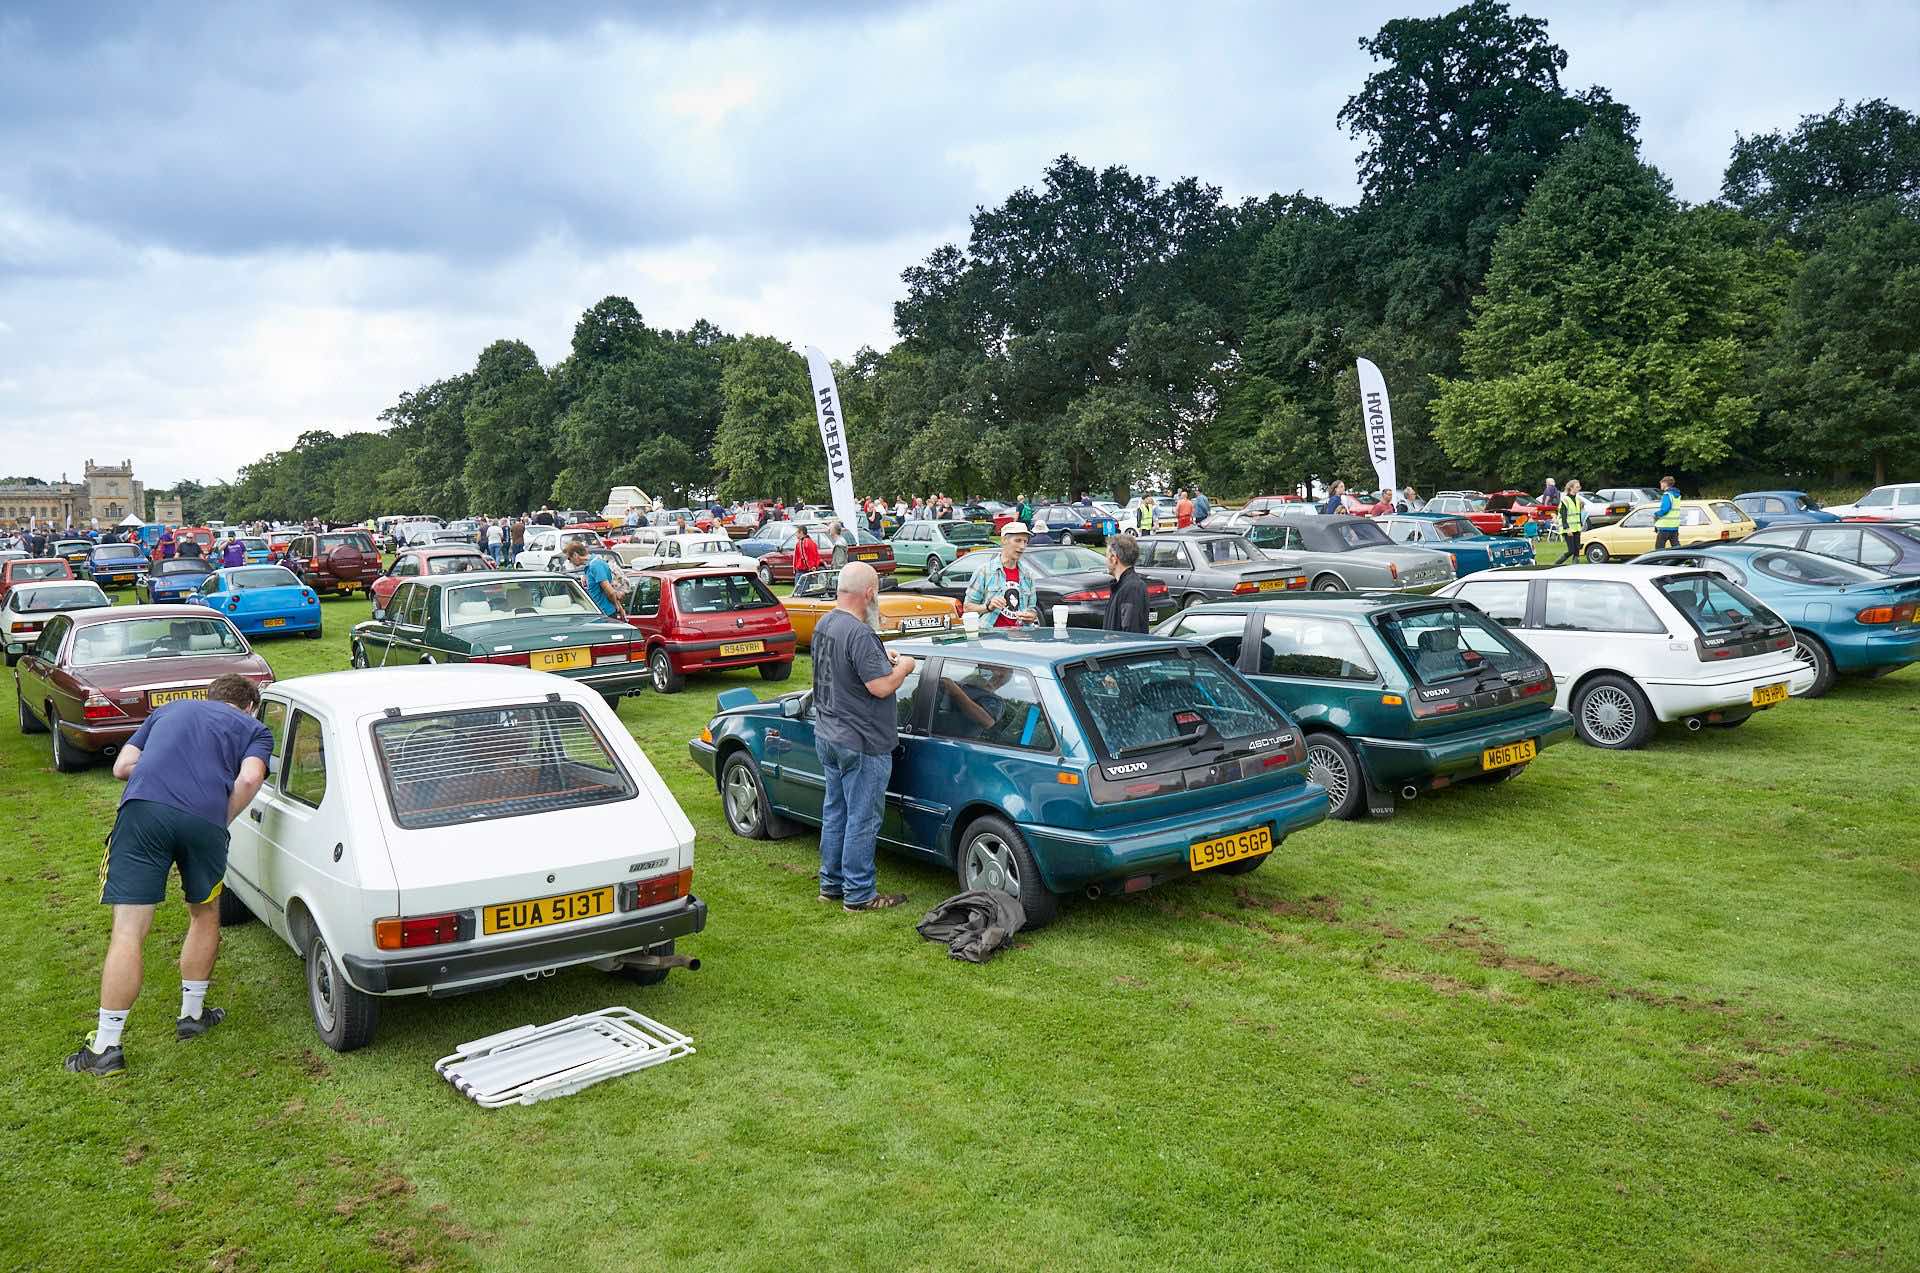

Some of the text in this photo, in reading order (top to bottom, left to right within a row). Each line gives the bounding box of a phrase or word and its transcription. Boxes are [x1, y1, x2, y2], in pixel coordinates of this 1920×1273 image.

[557, 652, 577, 664] BTY
[1423, 688, 1450, 698] VOLVO
[1269, 734, 1293, 745] TURBO
[1488, 743, 1531, 767] M616 TLS
[1107, 761, 1148, 776] VOLVO
[1192, 831, 1270, 867] L990 SGP
[496, 892, 605, 930] EUA 513T
